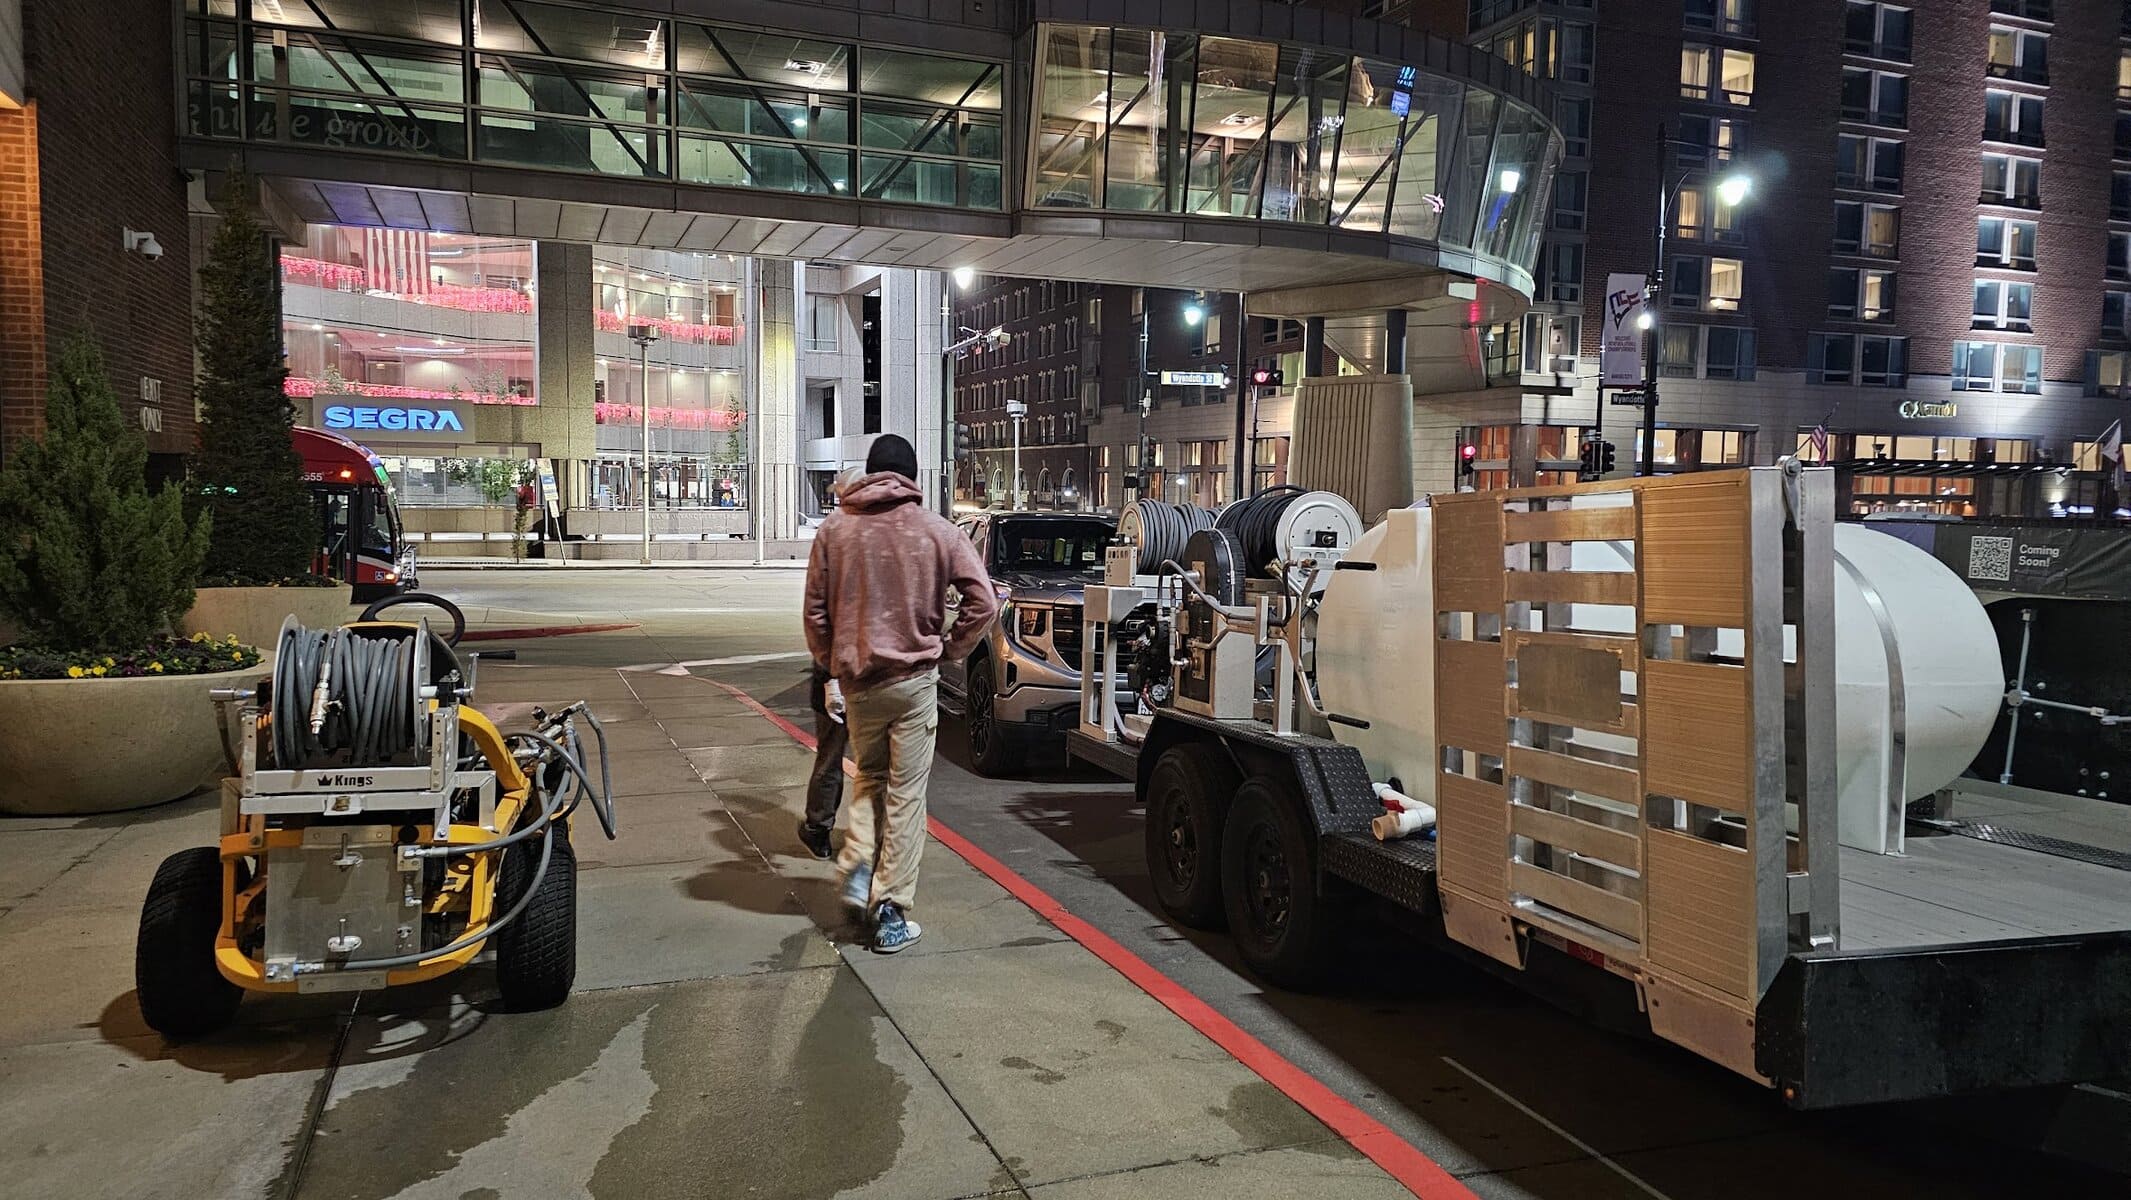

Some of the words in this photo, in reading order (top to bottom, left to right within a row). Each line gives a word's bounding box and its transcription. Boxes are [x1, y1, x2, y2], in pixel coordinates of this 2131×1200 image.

[142, 407, 162, 432] ONLY
[324, 406, 464, 431] SEGRA
[2020, 544, 2060, 558] Coming
[2019, 555, 2051, 568] Soon!
[335, 774, 374, 788] Kings
